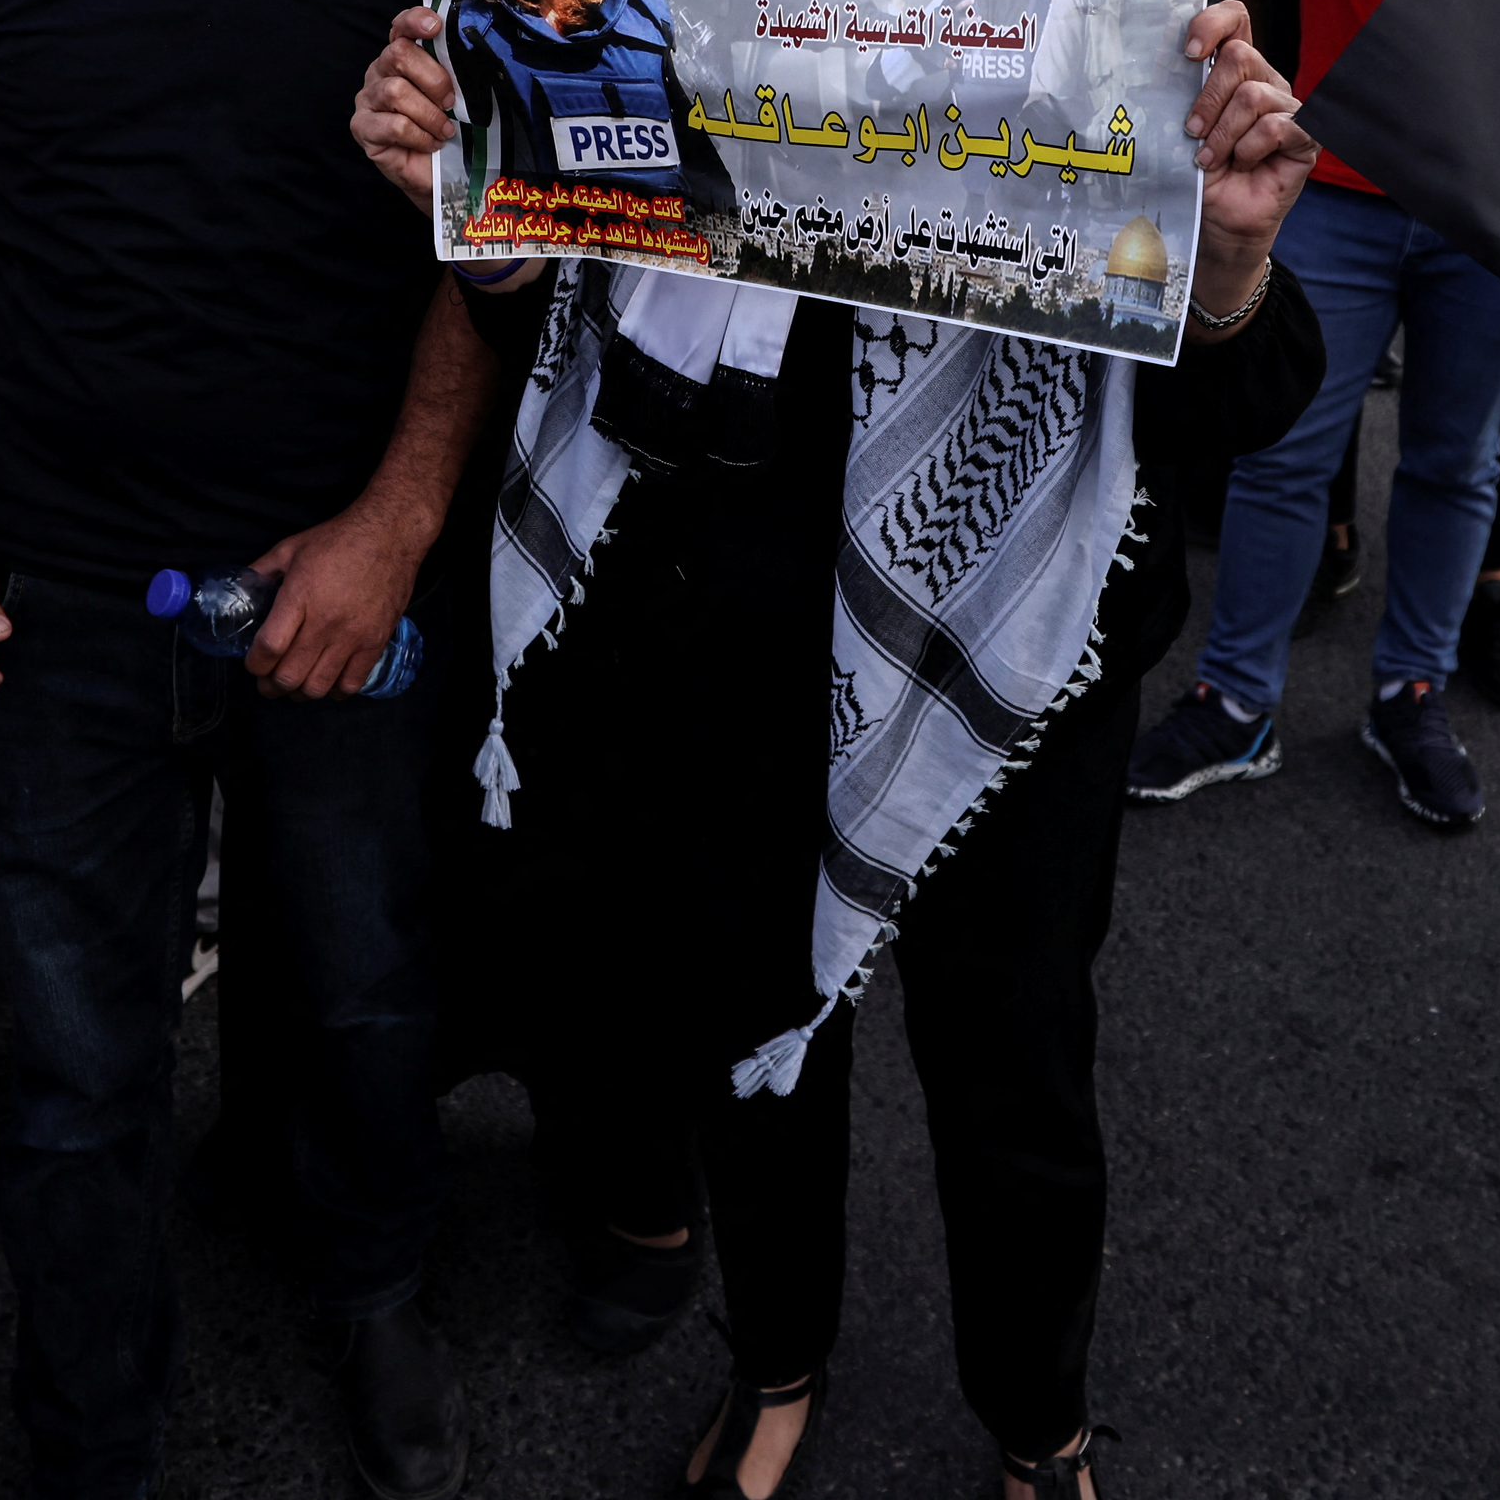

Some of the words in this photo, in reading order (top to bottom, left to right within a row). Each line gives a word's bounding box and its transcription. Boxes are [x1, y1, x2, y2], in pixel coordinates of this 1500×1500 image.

[843, 2, 934, 54] المقدسية
[939, 5, 1038, 57] الصحفية
[960, 54, 1026, 80] PRESS
[686, 83, 850, 149] عاقله
[852, 102, 931, 167] ابو
[569, 124, 670, 162] PRESS
[937, 103, 1136, 184] شيرين
[487, 180, 544, 208] جرائمكم
[546, 186, 569, 208] على
[572, 187, 623, 214] الحقيقه
[626, 198, 649, 219] عين
[653, 198, 683, 219] كانت
[739, 188, 790, 241] جنين
[514, 215, 572, 247] جرائمكم
[578, 222, 601, 243] على
[605, 224, 638, 246] شاهد
[792, 193, 845, 247] مخيم
[845, 193, 891, 255] أرض
[892, 204, 935, 260] على
[934, 207, 1032, 269] استشهدت
[640, 227, 709, 261] واستشهادها
[1030, 224, 1078, 289] التي
